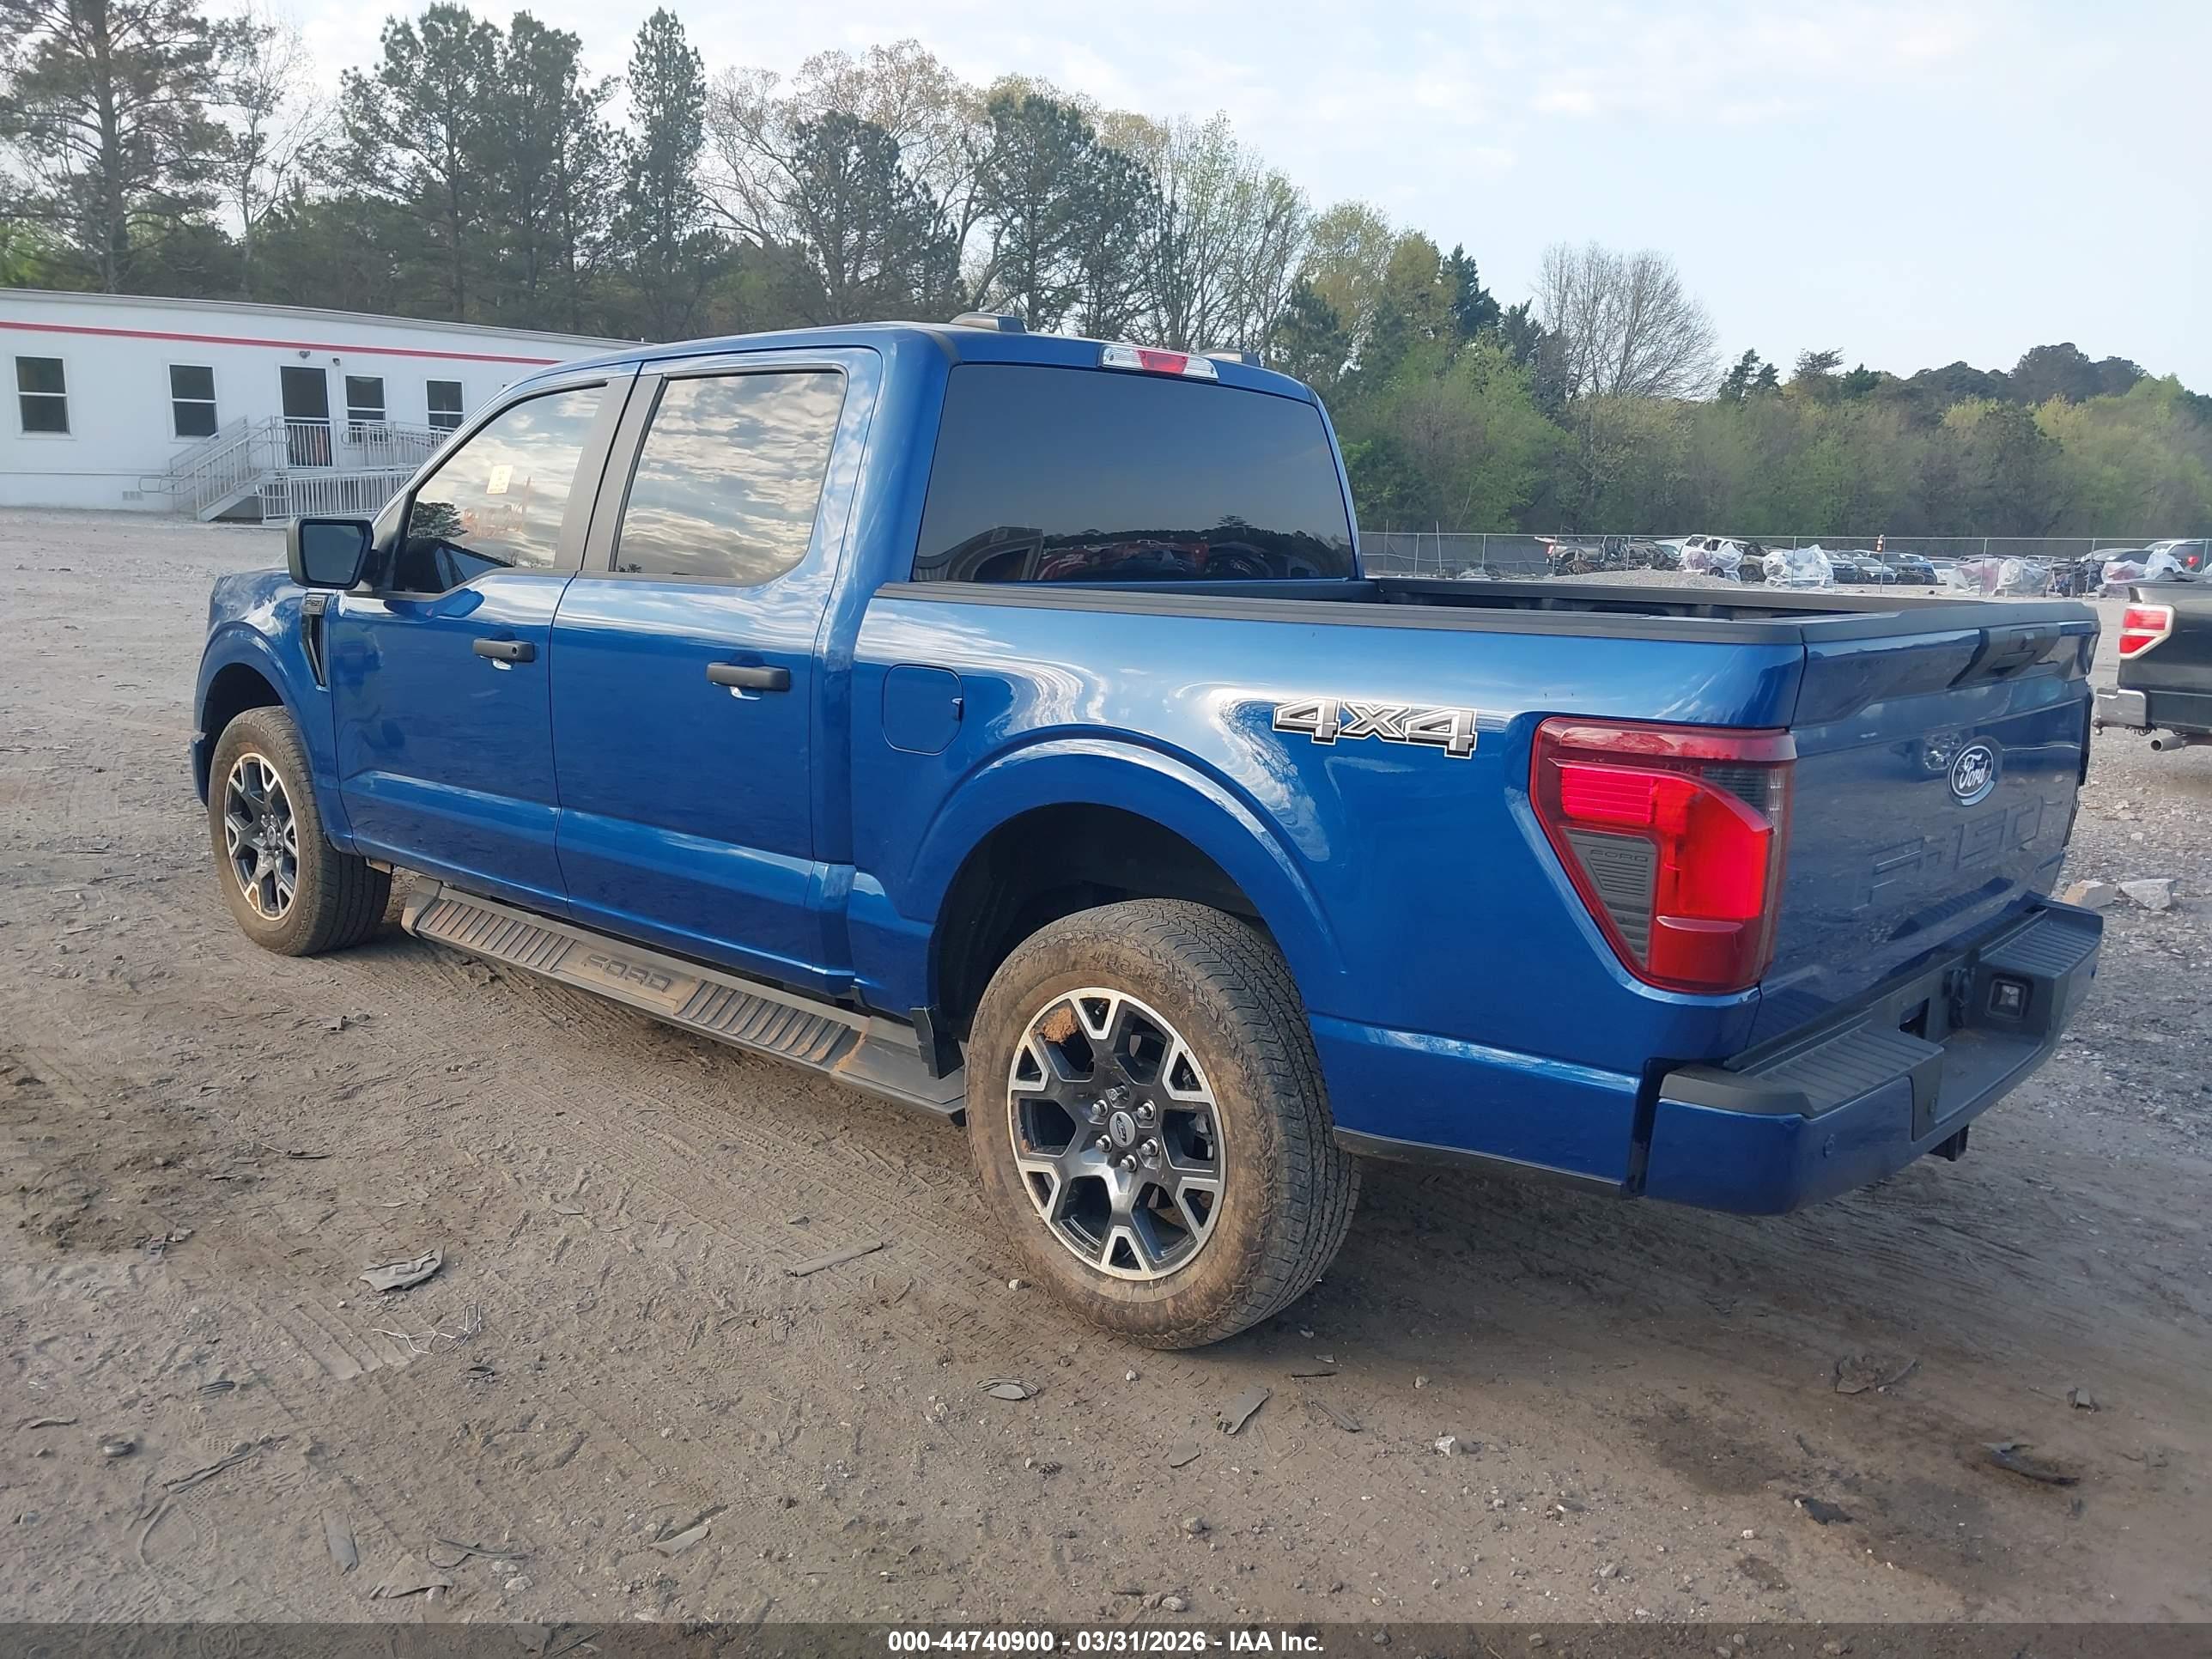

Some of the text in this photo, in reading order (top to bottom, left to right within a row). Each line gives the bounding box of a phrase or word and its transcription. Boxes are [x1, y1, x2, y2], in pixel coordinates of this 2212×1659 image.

[1959, 752, 1990, 790] Ford
[1589, 848, 1650, 863] FORD
[1850, 795, 2045, 913] F-150
[580, 952, 673, 994] FORD
